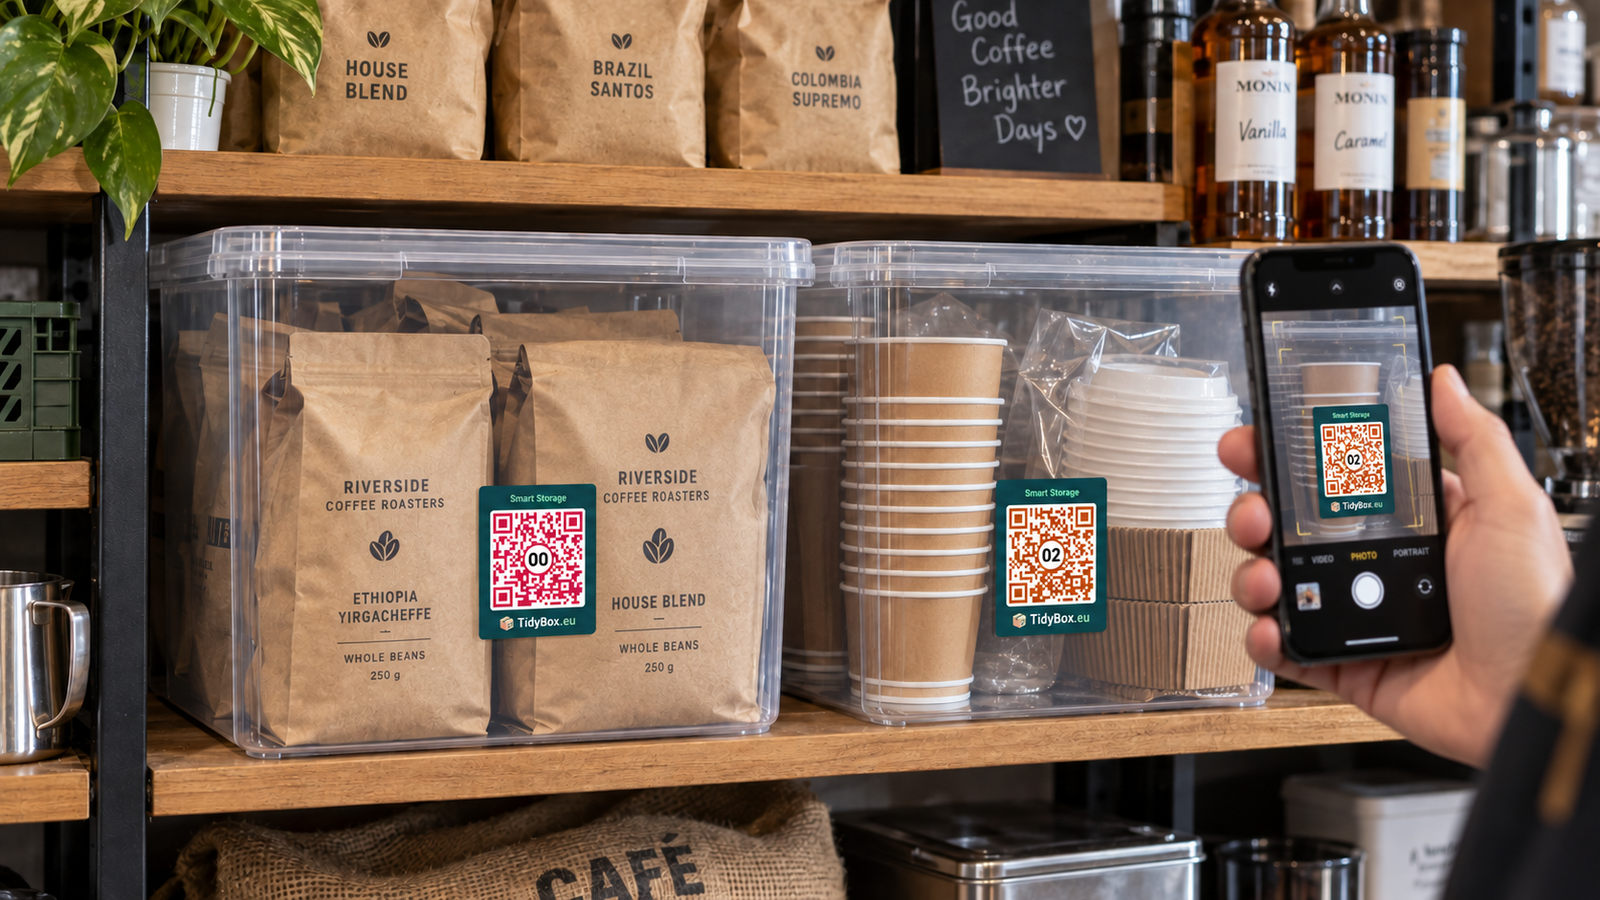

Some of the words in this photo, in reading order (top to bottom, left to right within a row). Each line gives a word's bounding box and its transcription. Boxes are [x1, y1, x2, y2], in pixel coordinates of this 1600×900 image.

[951, 0, 1018, 32] Good
[972, 33, 1055, 66] Coffee
[346, 60, 408, 79] HOUSE
[593, 60, 652, 79] BRAZIL
[792, 72, 862, 89] COLOMBIA
[346, 82, 407, 101] BLEND
[591, 81, 654, 99] SANTOS
[961, 72, 1067, 113] Brighter
[793, 92, 861, 110] SUPREMO
[994, 114, 1057, 154] Days
[1239, 118, 1287, 142] Vanilla
[1334, 130, 1388, 151] Caramel
[1347, 454, 1361, 465] 02
[618, 469, 697, 485] RIVERSIDE
[344, 479, 429, 494] RIVERSIDE
[1025, 489, 1048, 498] Smart
[1050, 488, 1080, 498] Storage
[326, 500, 376, 511] COFFEE
[381, 498, 445, 510] ROASTERS
[510, 494, 534, 503] Smart
[536, 494, 567, 504] Storage
[603, 491, 648, 504] COFFEE
[652, 490, 710, 502] ROASTERS
[528, 552, 548, 567] 00
[1042, 548, 1061, 562] 02
[1311, 555, 1334, 564] VIDEO
[1350, 551, 1378, 561] PHOTO
[1393, 547, 1430, 558] PORTRAIT
[353, 590, 418, 605] ETHIOPIA
[611, 595, 658, 610] HOUSE
[662, 593, 706, 608] BLEND
[338, 607, 431, 624] YIRGACHEFFE
[517, 616, 576, 630] TidyBox.eu
[1030, 613, 1090, 627] TidyBox.eu
[619, 642, 659, 654] WHOLE
[663, 640, 699, 652] BEANS
[344, 653, 385, 664] WHOLE
[390, 650, 425, 662] BEANS
[370, 671, 391, 681] 250
[394, 671, 401, 681] g
[645, 662, 665, 673] 250
[667, 663, 674, 674] g
[536, 833, 705, 900] CAFÉ
